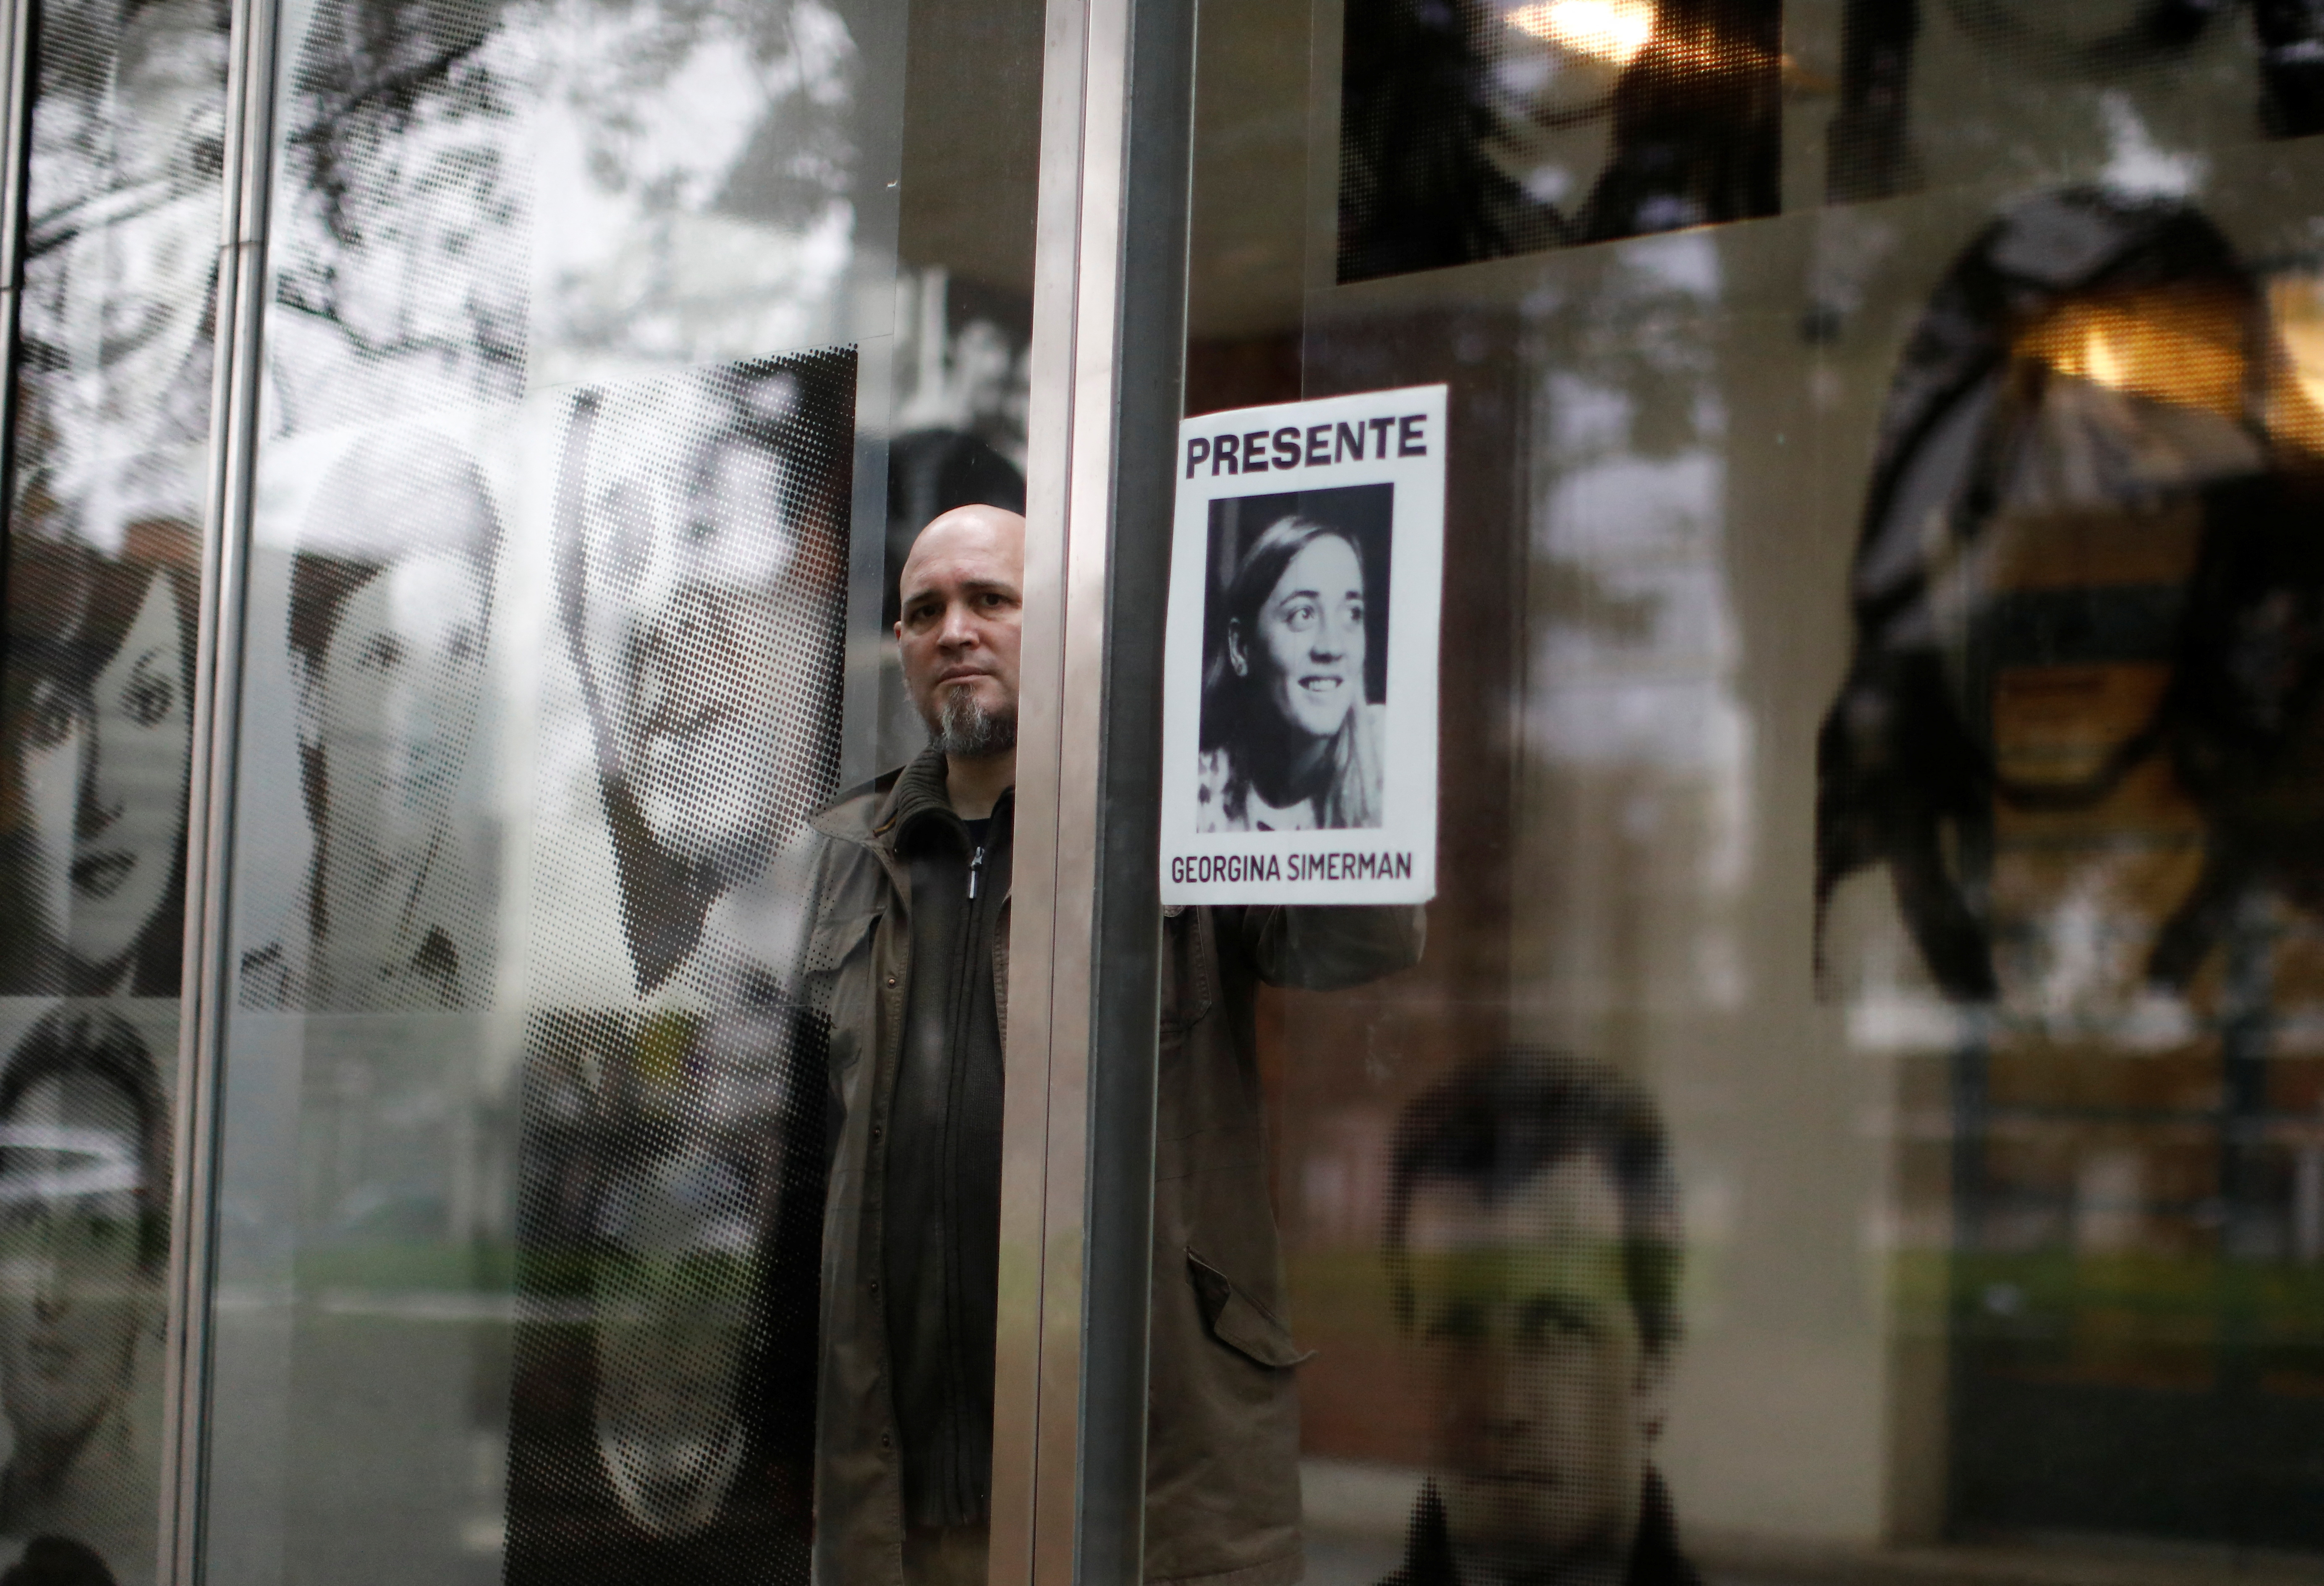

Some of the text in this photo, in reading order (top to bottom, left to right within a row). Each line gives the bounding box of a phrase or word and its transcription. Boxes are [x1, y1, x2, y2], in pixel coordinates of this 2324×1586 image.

[1186, 414, 1428, 479] PRESENTE
[1172, 852, 1412, 883] GEORGINA SIMERMAN
